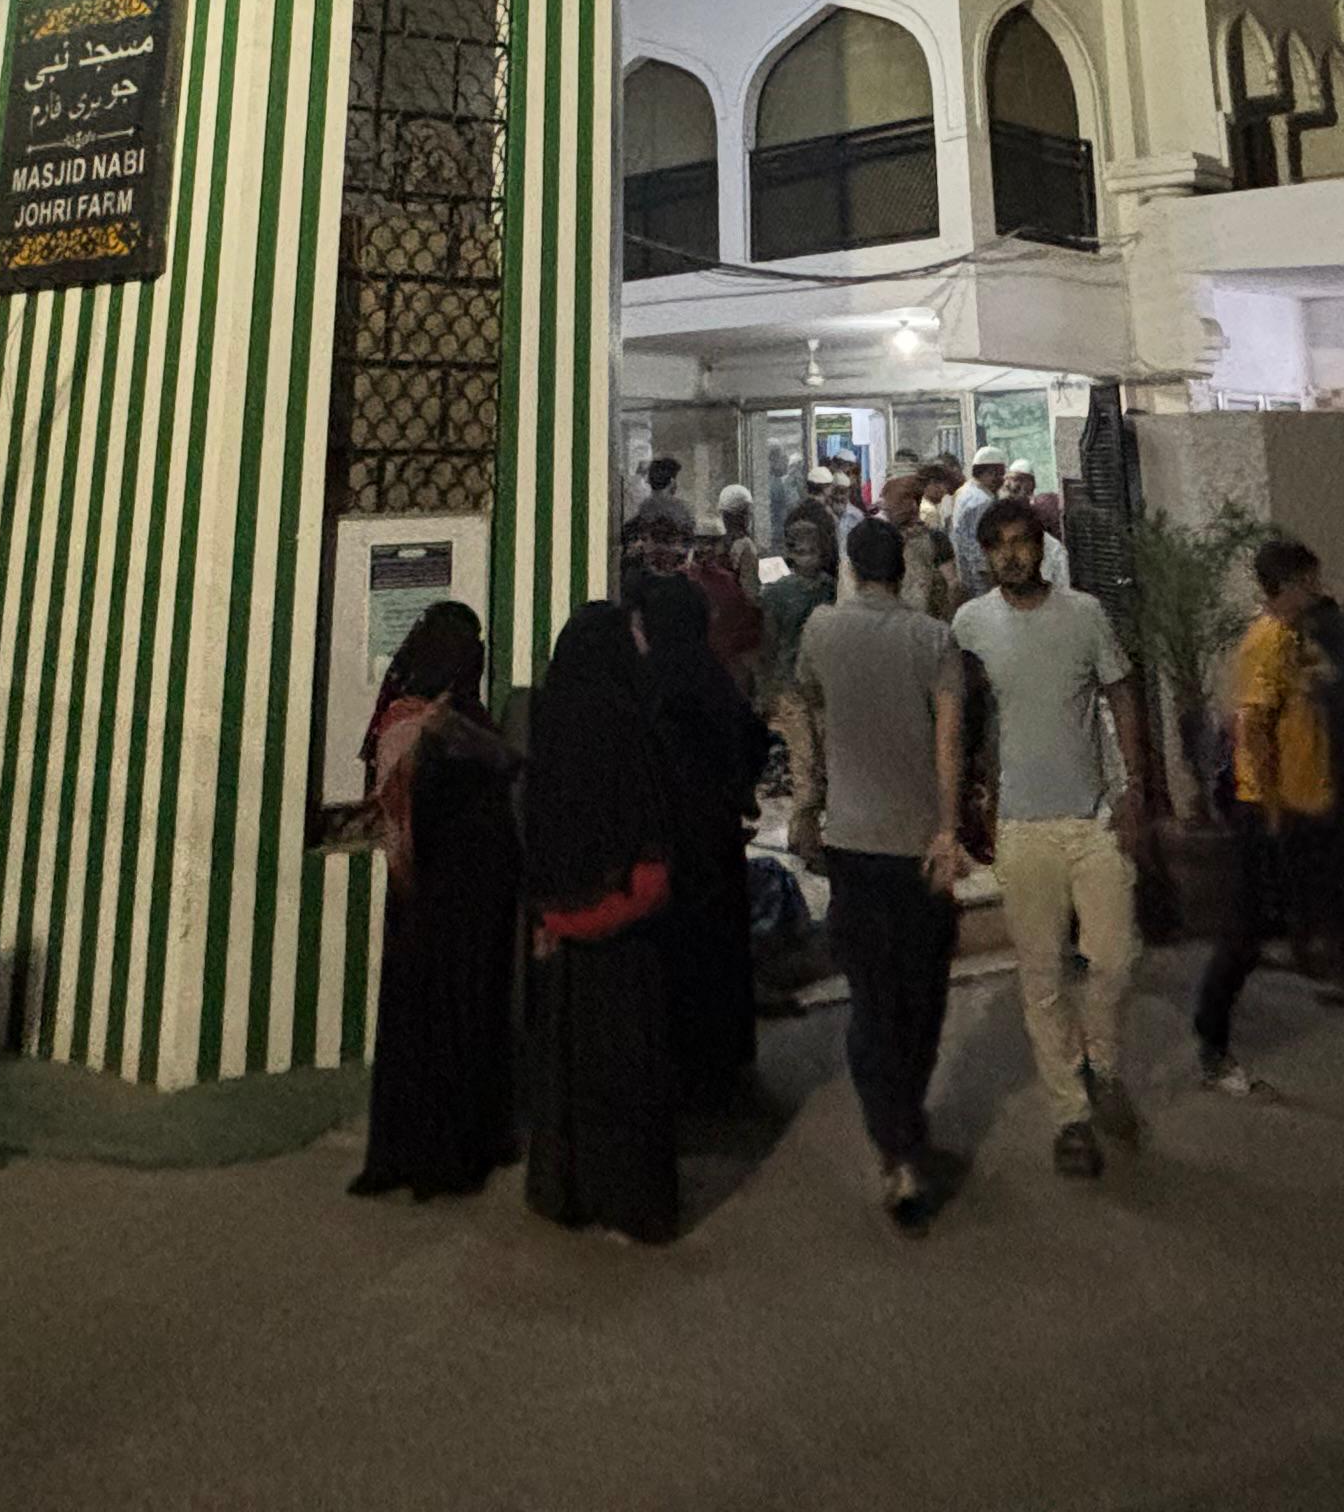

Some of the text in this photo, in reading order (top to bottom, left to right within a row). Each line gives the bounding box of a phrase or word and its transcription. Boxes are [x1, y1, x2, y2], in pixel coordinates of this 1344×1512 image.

[79, 35, 154, 73] مسجد
[11, 147, 145, 192] MASJID NABI
[13, 188, 134, 229] JOHRI FARM
